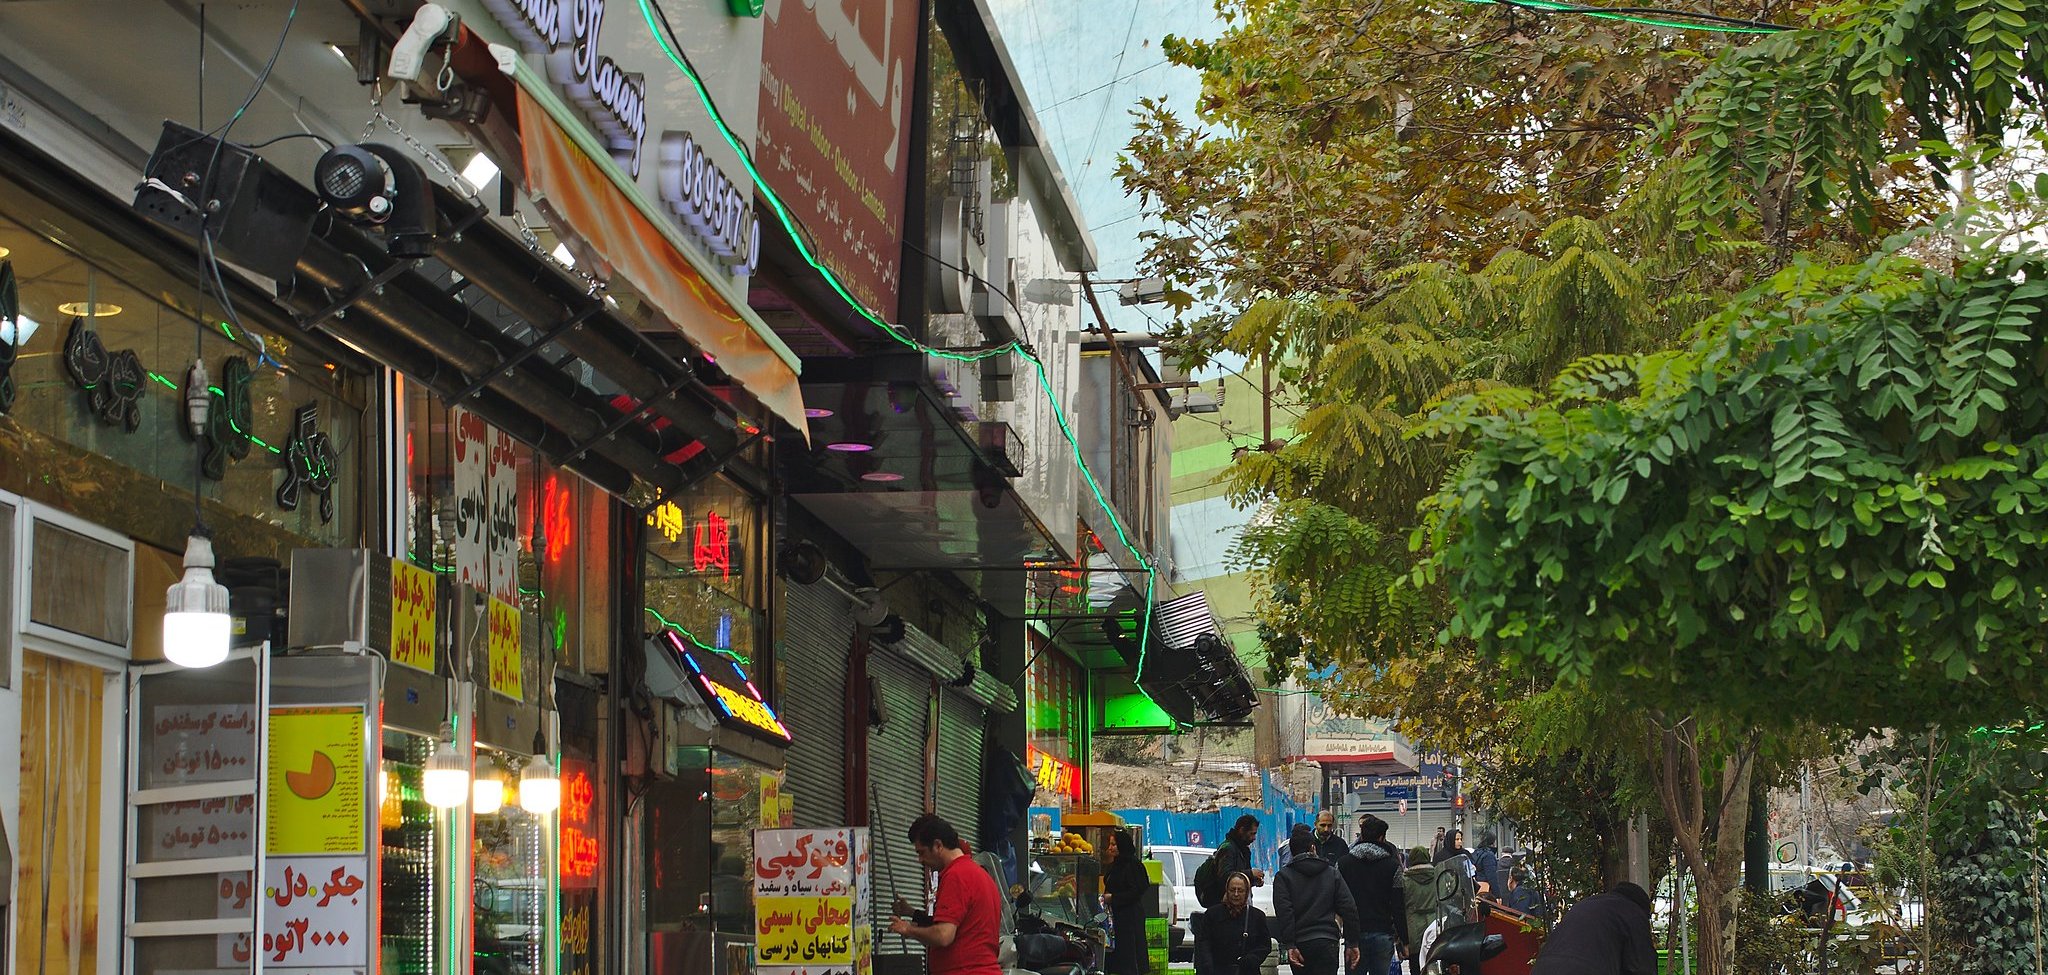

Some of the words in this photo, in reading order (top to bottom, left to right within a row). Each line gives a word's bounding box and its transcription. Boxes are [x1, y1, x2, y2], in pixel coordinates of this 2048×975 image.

[784, 83, 807, 132] Digital
[810, 114, 831, 161] Indoor
[834, 145, 859, 193] Outdoor
[681, 131, 761, 278] 88951790
[456, 475, 486, 544] درسی
[394, 565, 408, 612] قلوه
[410, 572, 424, 617] جگر
[426, 576, 435, 620] دل
[396, 628, 411, 662] تومان
[413, 619, 431, 662] ۲۰۰۰
[501, 609, 511, 649] جگر
[156, 711, 217, 736] گوسفندی
[163, 750, 201, 775] تومان
[204, 750, 247, 771] ۱۵۰۰۰
[162, 826, 205, 848] تومان
[207, 824, 248, 842] ۵۰۰۰
[756, 830, 848, 881] فتوکپی
[274, 865, 308, 907] دل
[317, 865, 364, 907] جگر
[758, 880, 781, 893] سفید
[784, 886, 789, 896] و
[792, 880, 812, 895] سیاه
[758, 908, 794, 935] سیمی
[805, 898, 851, 935] صحافی
[232, 920, 294, 963] تومن
[760, 937, 798, 960] درسی
[802, 934, 849, 960] کتابهای
